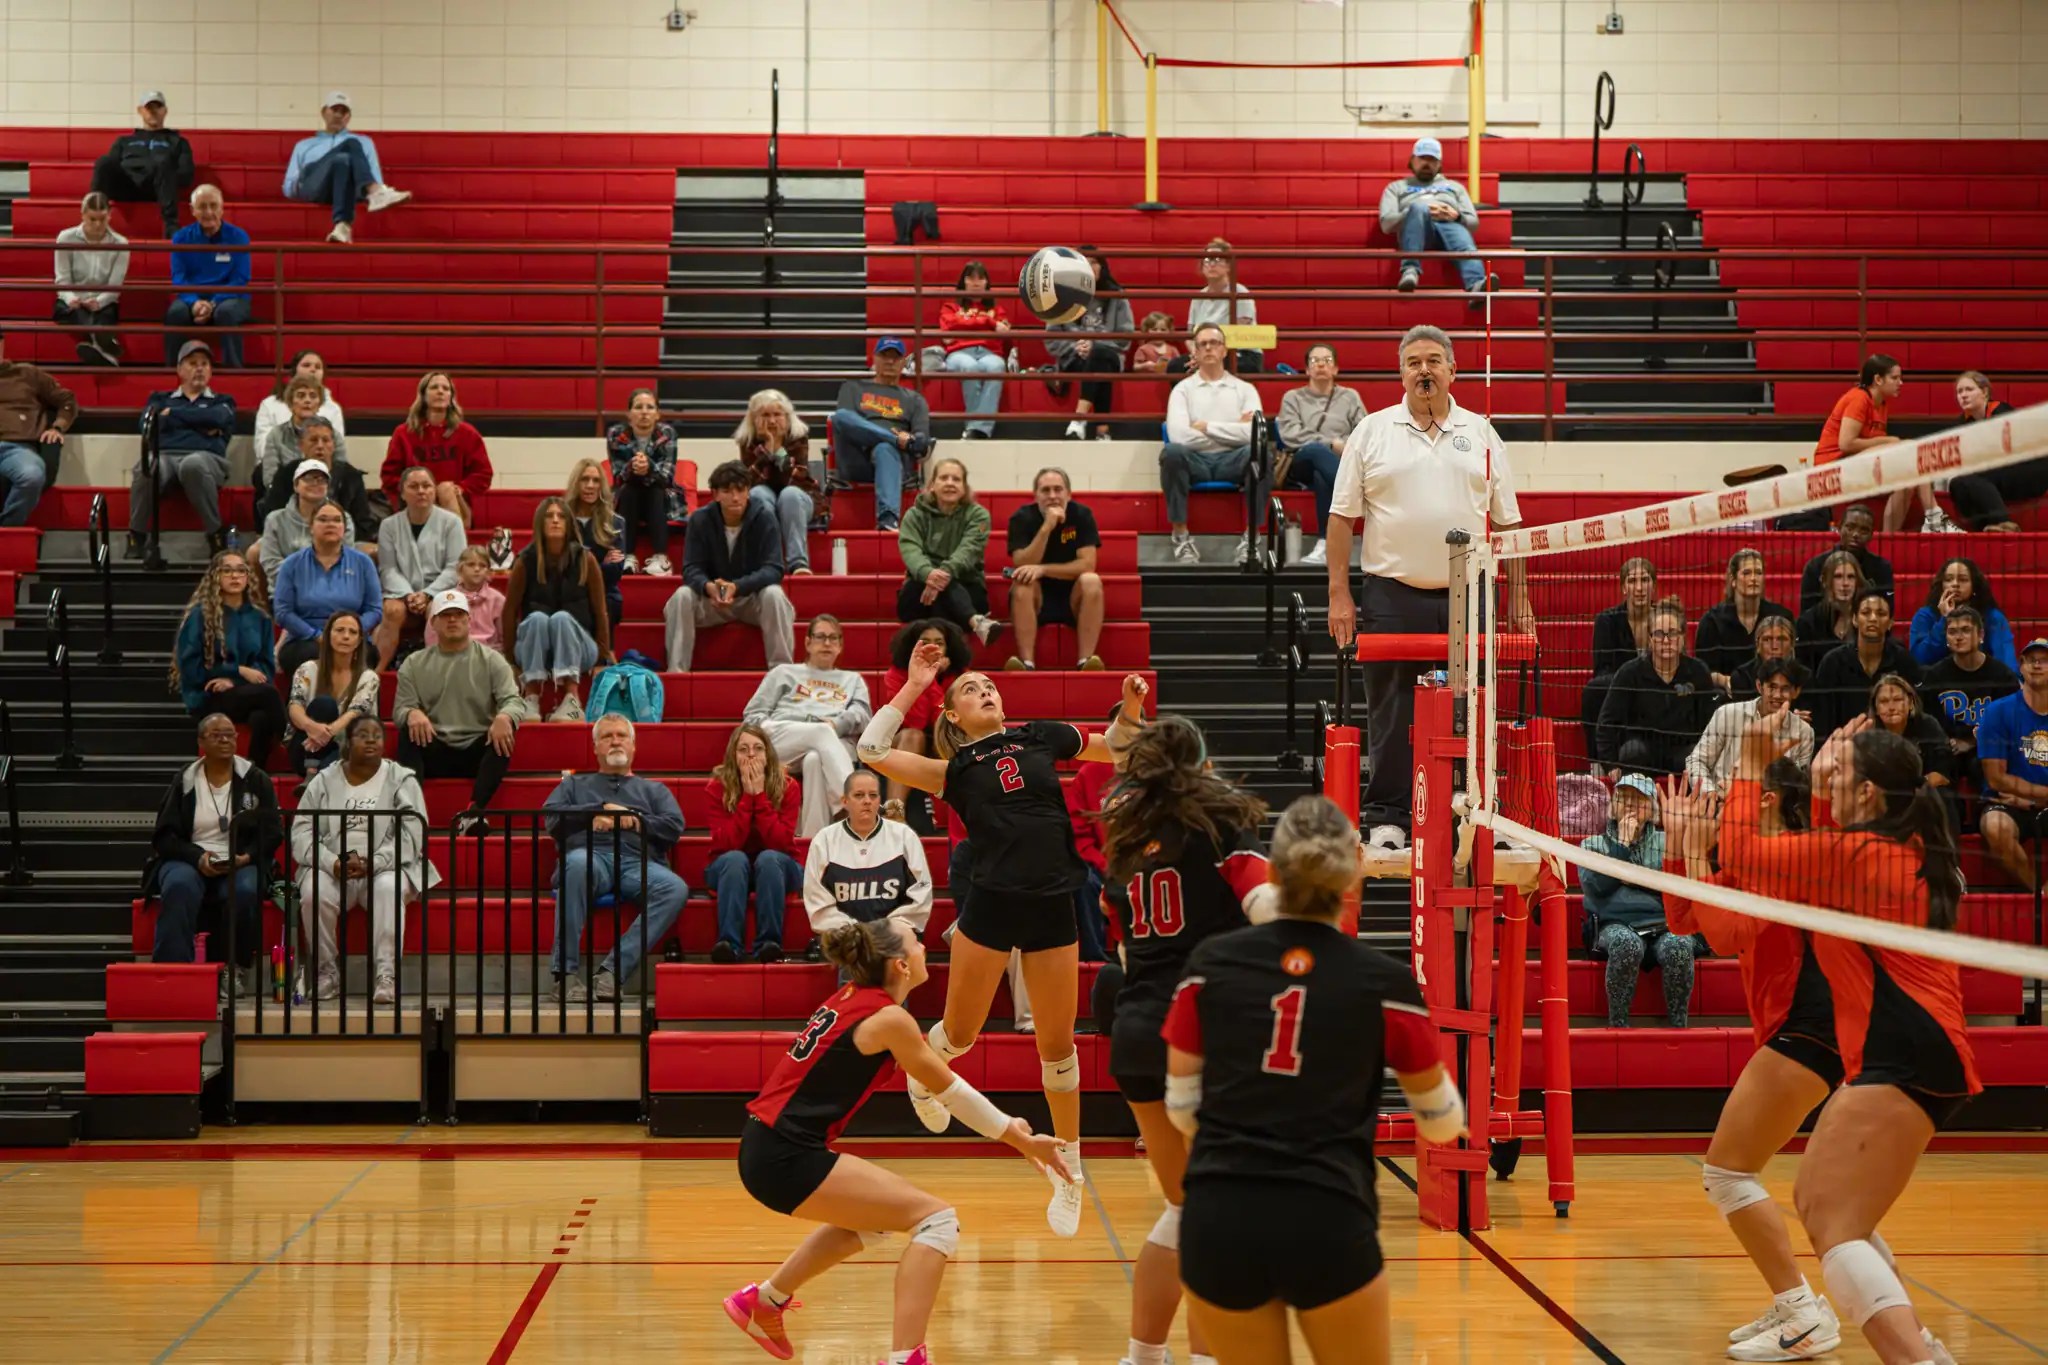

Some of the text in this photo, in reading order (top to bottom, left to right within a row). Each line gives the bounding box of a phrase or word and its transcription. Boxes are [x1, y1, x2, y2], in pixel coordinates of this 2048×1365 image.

[1917, 435, 1962, 476] HUSKIES
[1807, 466, 1842, 501] HUSKIES
[995, 756, 1025, 793] 2
[834, 878, 901, 902] BILLS
[1126, 866, 1186, 938] 10
[1415, 838, 1427, 998] HUSK
[786, 1005, 839, 1062] 3
[1261, 984, 1307, 1076] 1
